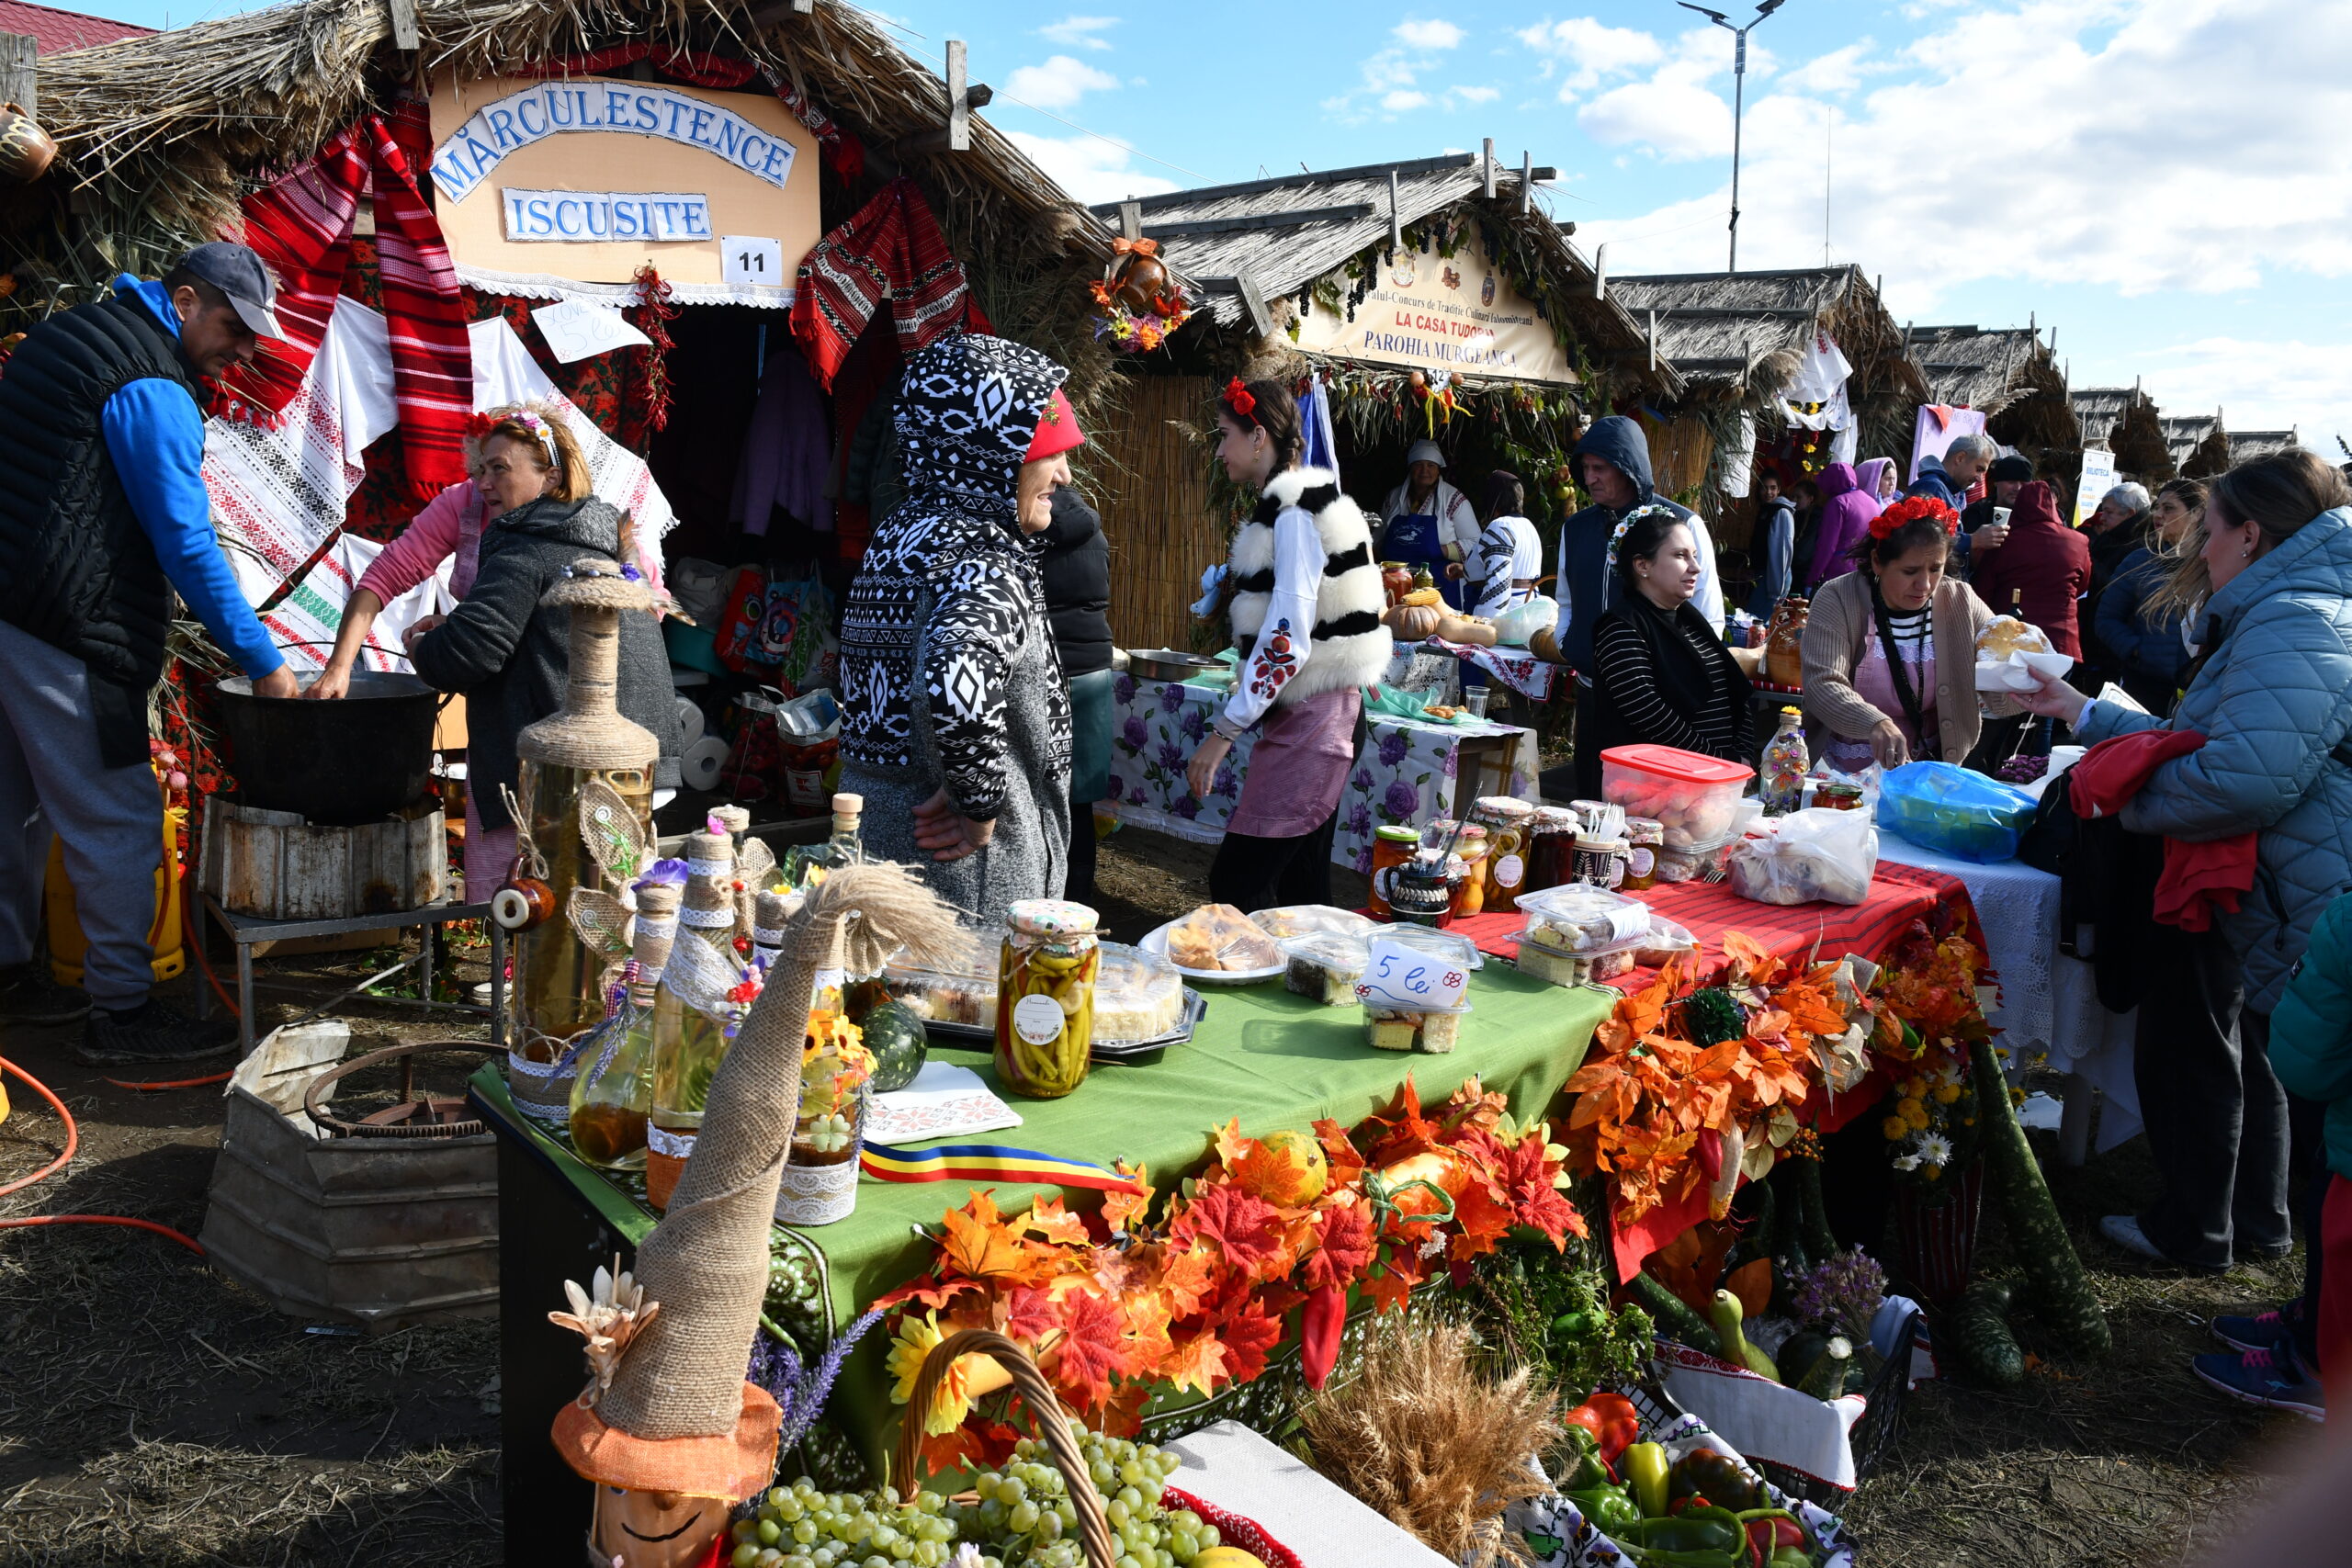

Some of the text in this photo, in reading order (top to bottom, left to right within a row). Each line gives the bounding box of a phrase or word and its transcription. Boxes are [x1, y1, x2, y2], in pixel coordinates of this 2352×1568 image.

[434, 90, 791, 198] MĂRCULESTENCE
[513, 197, 709, 236] ISCUSITE
[739, 252, 764, 273] 11
[1426, 299, 1435, 311] de
[560, 320, 588, 353] 5
[1396, 311, 1412, 329] LA
[1416, 315, 1448, 335] CASA
[1363, 331, 1517, 367] PAROHIA MURGEANCA
[1432, 369, 1445, 383] 12
[1377, 954, 1436, 994] 5 lei
